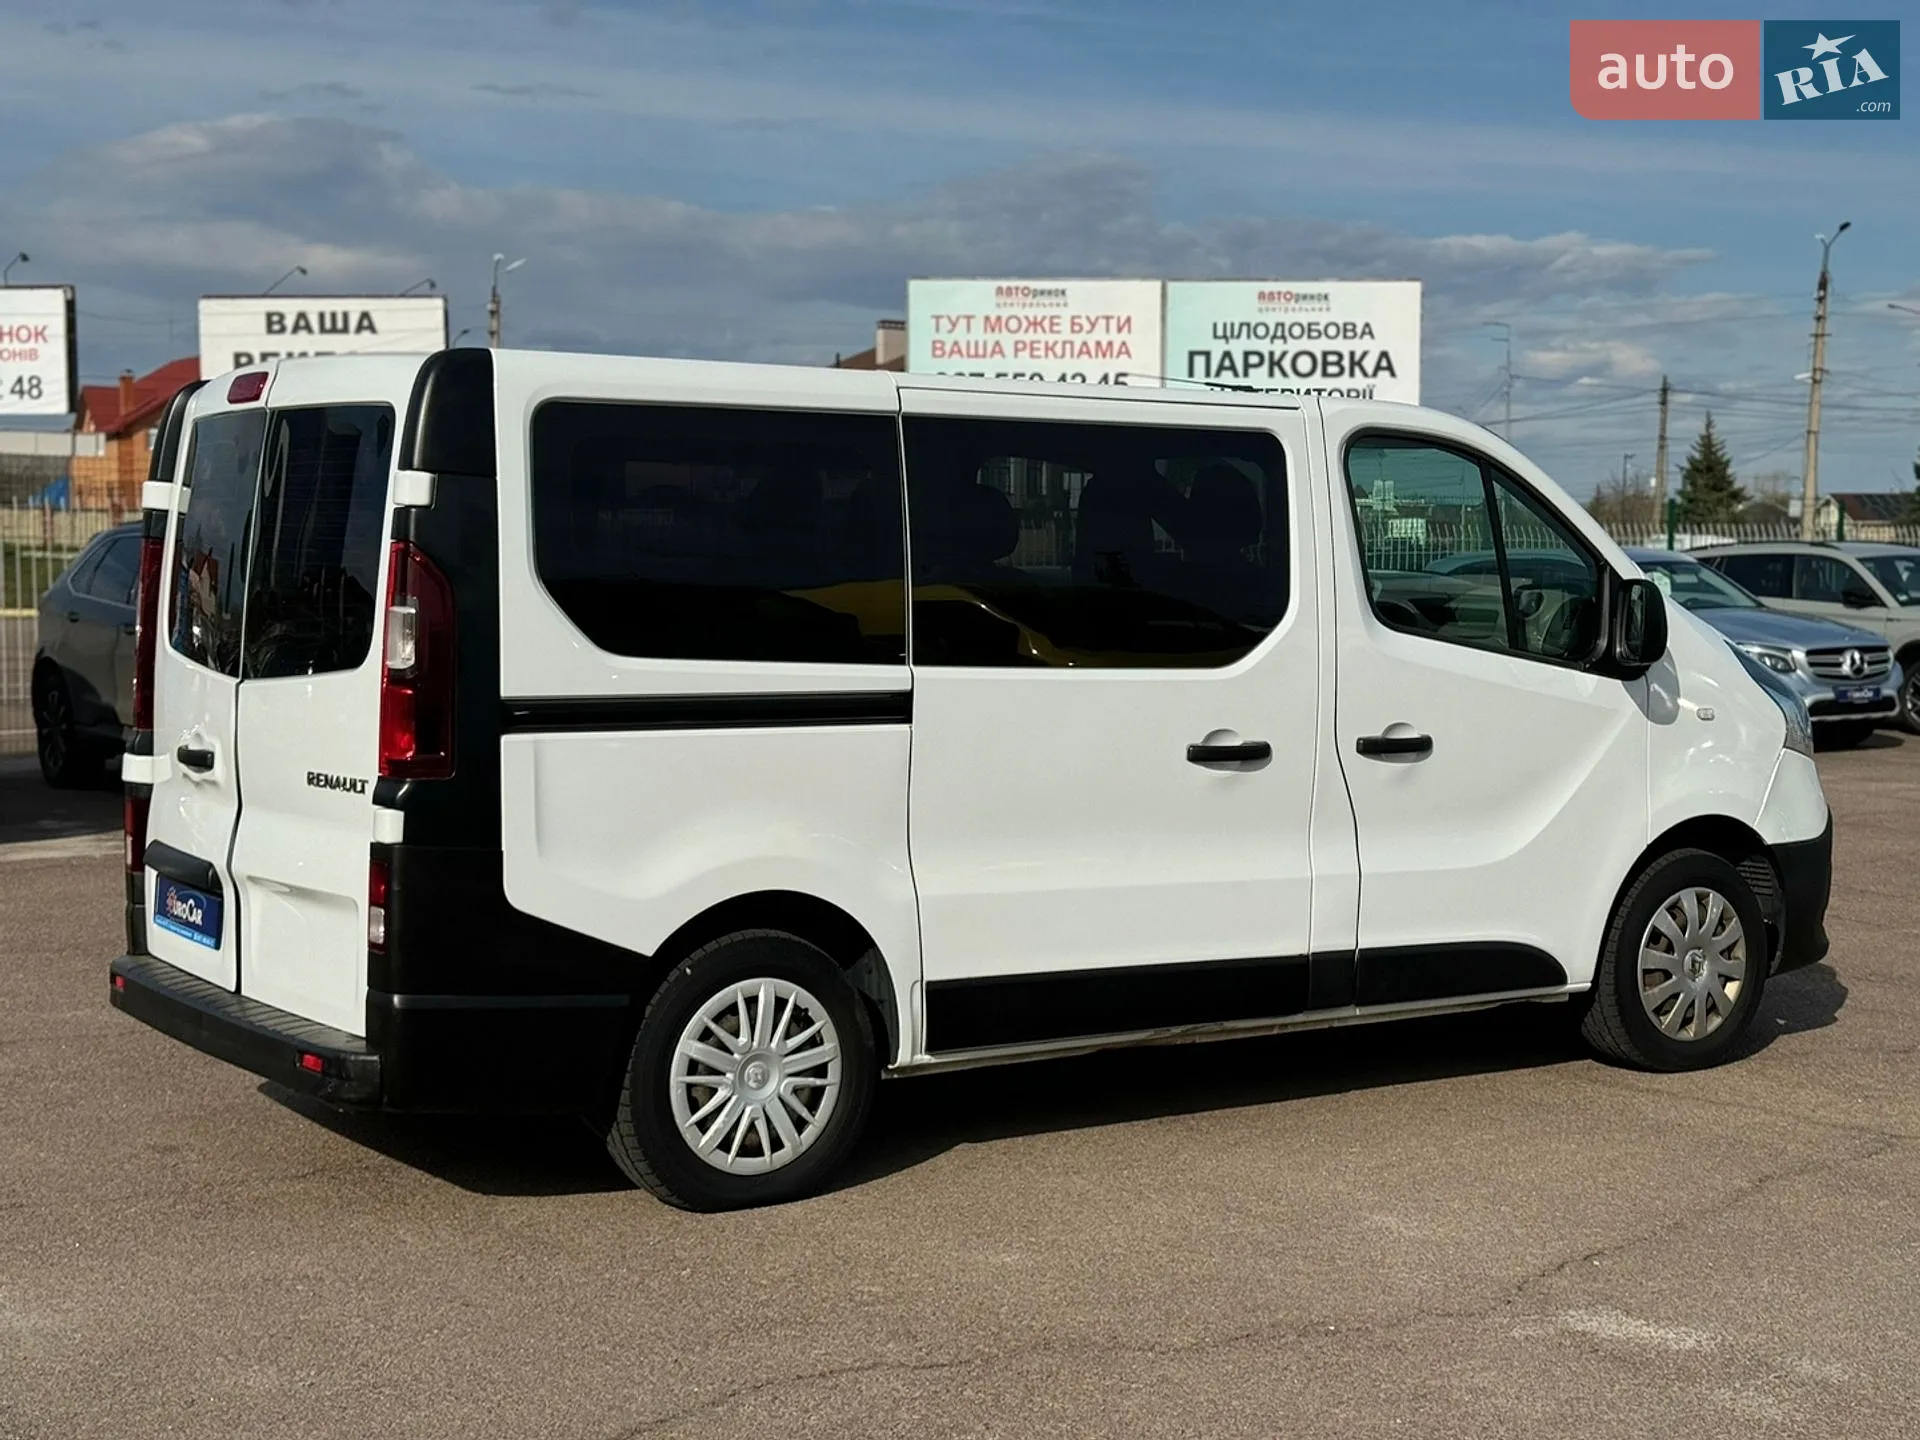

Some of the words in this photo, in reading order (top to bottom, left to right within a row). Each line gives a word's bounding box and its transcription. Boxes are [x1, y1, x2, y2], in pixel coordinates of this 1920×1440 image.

[265, 311, 377, 335] ВАША
[931, 315, 976, 334] ТУТ
[983, 315, 1062, 334] МОЖЕ
[1069, 315, 1132, 334] БУТИ
[1212, 322, 1375, 344] ЦІЛОДОБОВА
[931, 340, 1006, 359] ВАША
[1013, 340, 1132, 359] РЕКЛАМА
[1187, 350, 1397, 378] ПАРКОВКА
[307, 771, 369, 795] RENAULT
